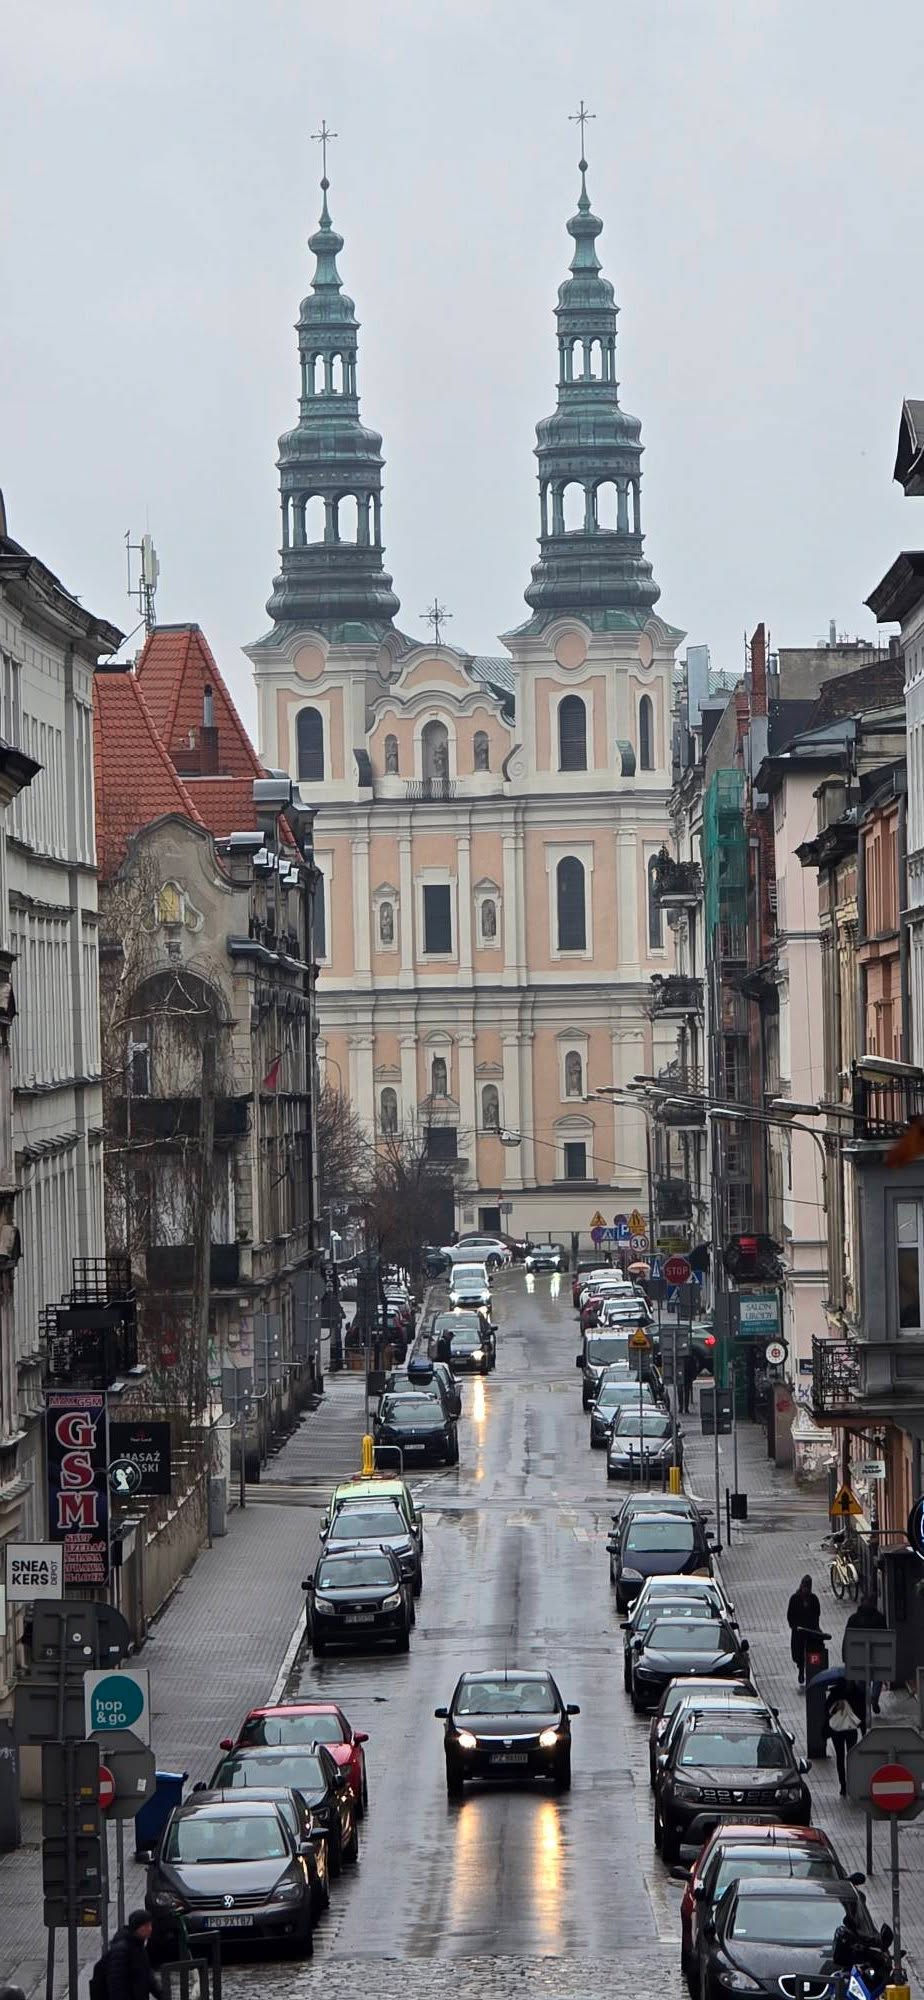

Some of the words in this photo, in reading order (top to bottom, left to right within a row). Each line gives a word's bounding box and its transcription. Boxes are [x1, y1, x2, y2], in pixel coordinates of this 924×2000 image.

[633, 1239, 645, 1248] 30
[666, 1266, 688, 1276] STOP
[745, 1303, 772, 1311] SALON
[120, 1450, 161, 1462] MASAŻ
[55, 1412, 99, 1528] GSM
[12, 1560, 49, 1572] SNEA
[12, 1573, 49, 1585] KERS
[96, 1699, 122, 1713] hop
[108, 1713, 127, 1726] go
